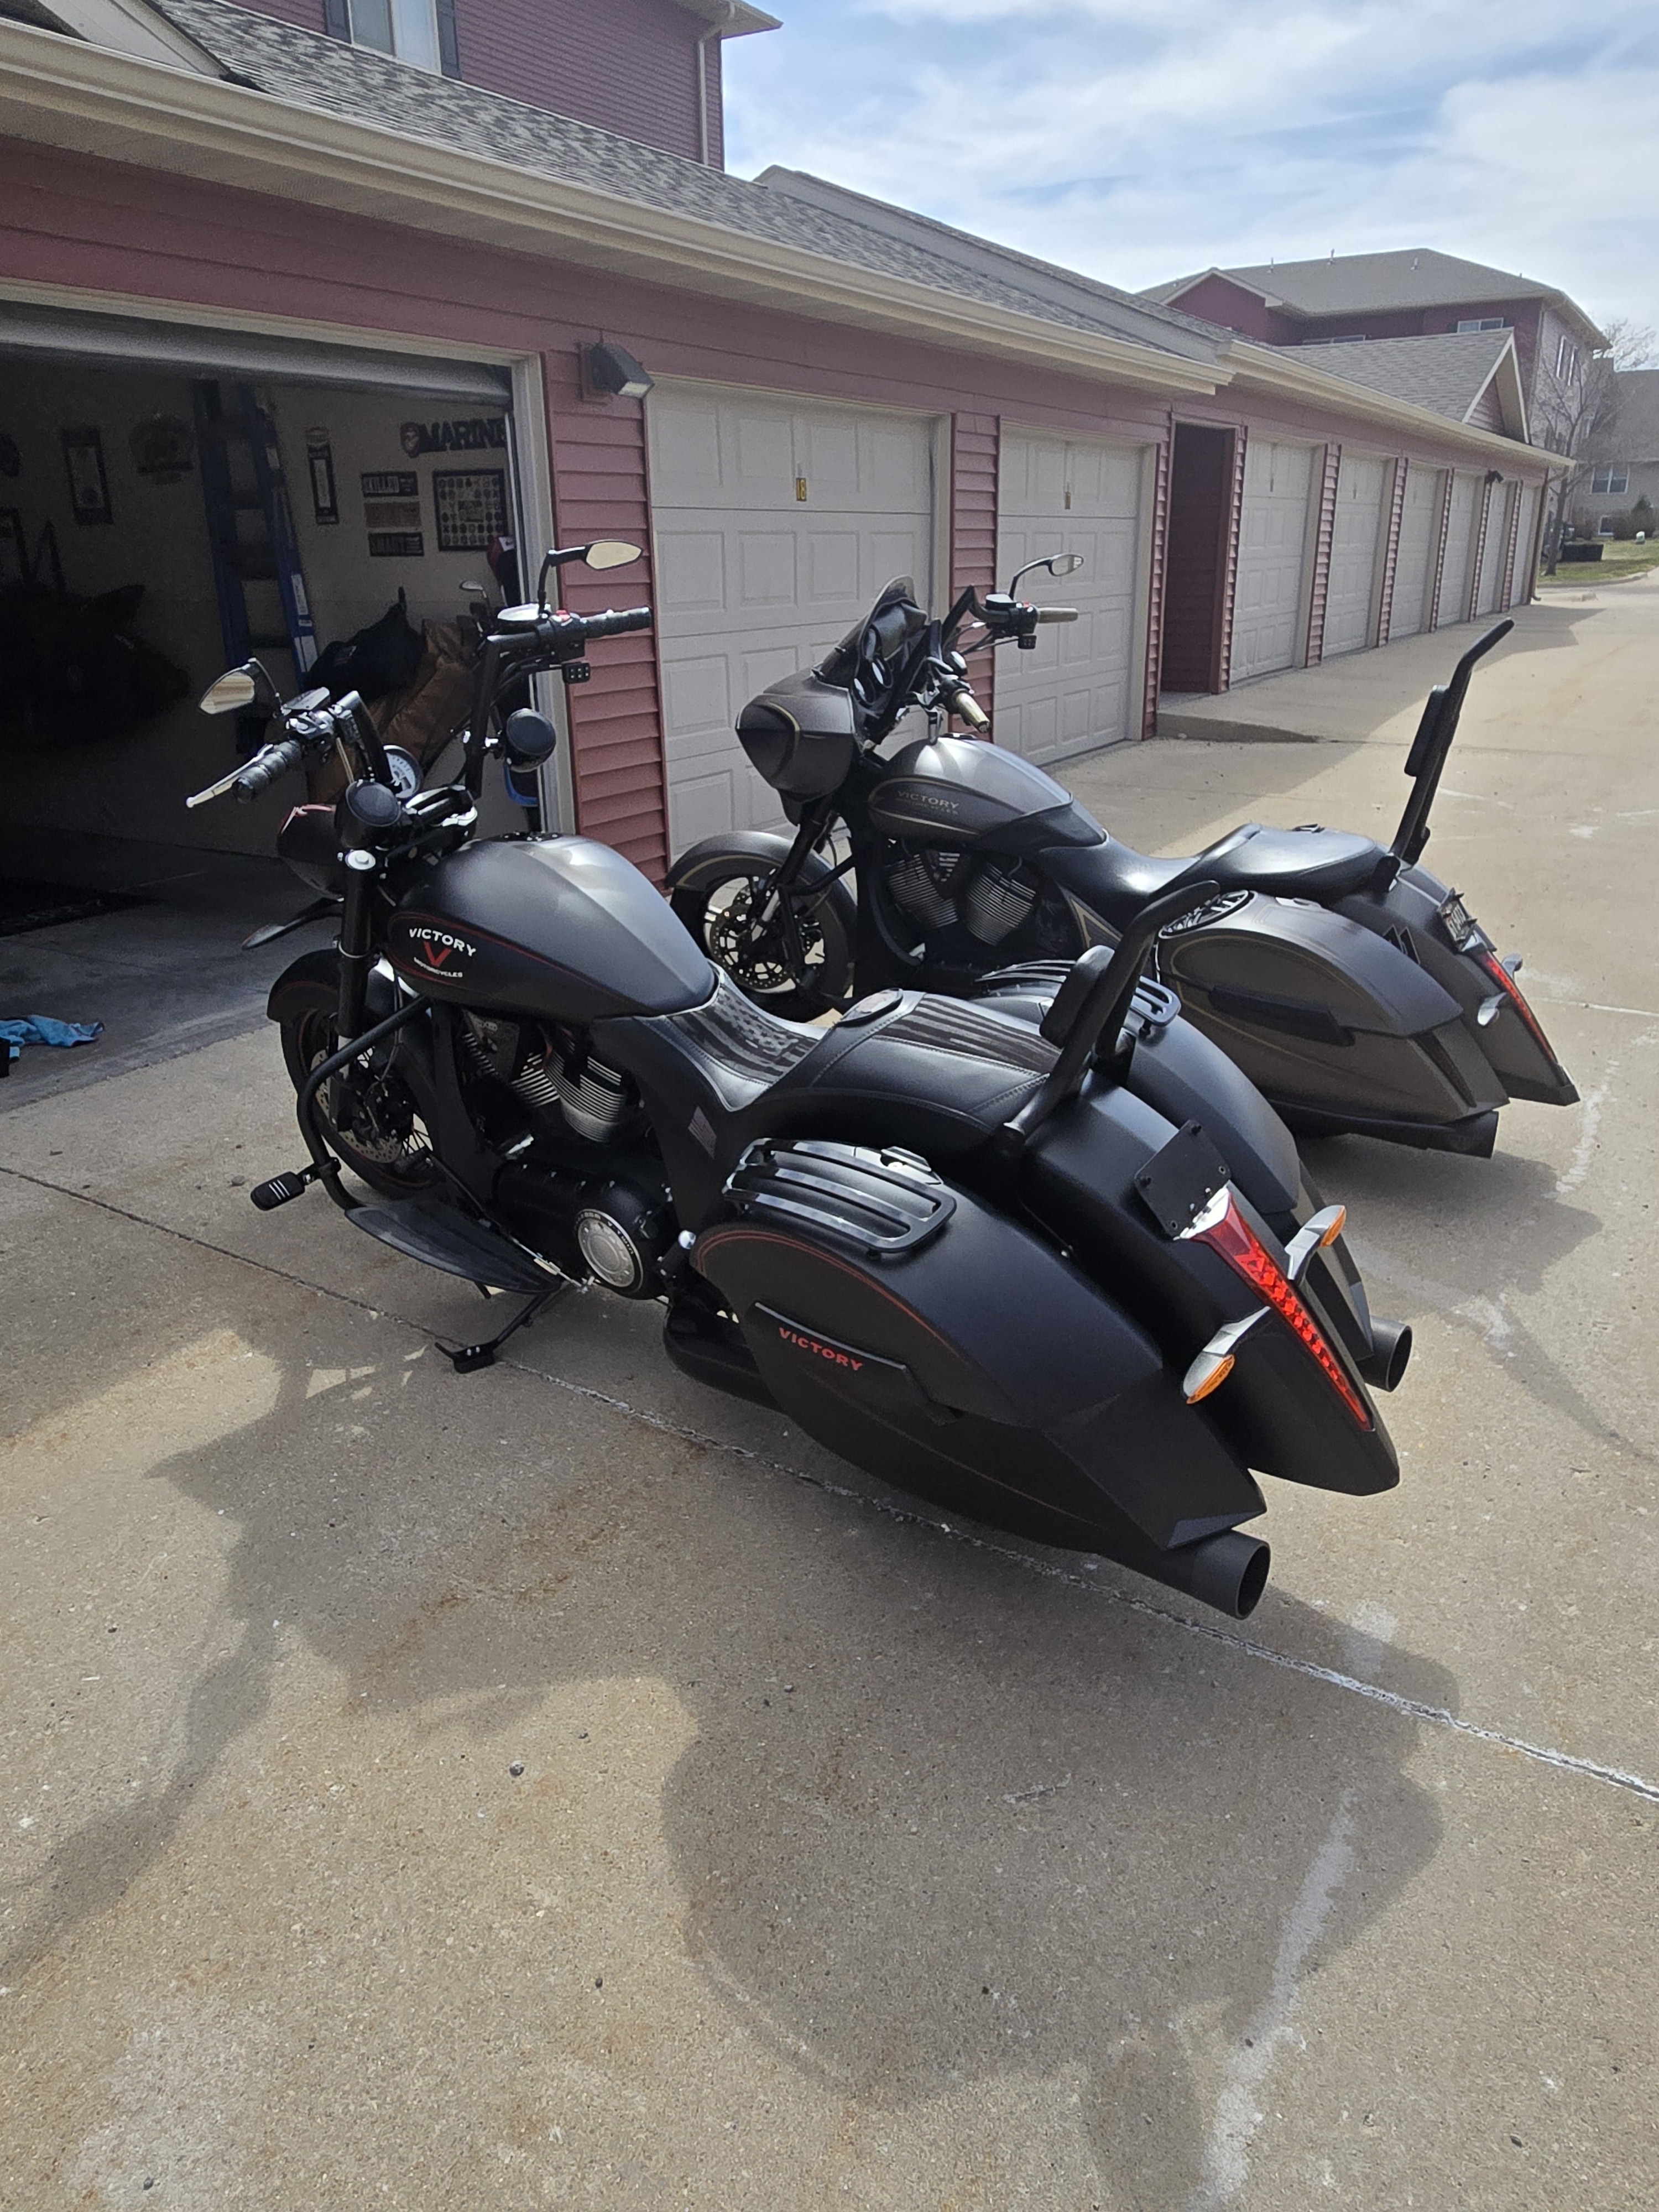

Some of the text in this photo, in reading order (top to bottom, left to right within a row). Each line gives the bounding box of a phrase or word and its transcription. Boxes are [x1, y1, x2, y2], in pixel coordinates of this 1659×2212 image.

[898, 790, 960, 809] VICTORY
[409, 928, 476, 957] VICTORY
[779, 1327, 863, 1371] VICTORY
